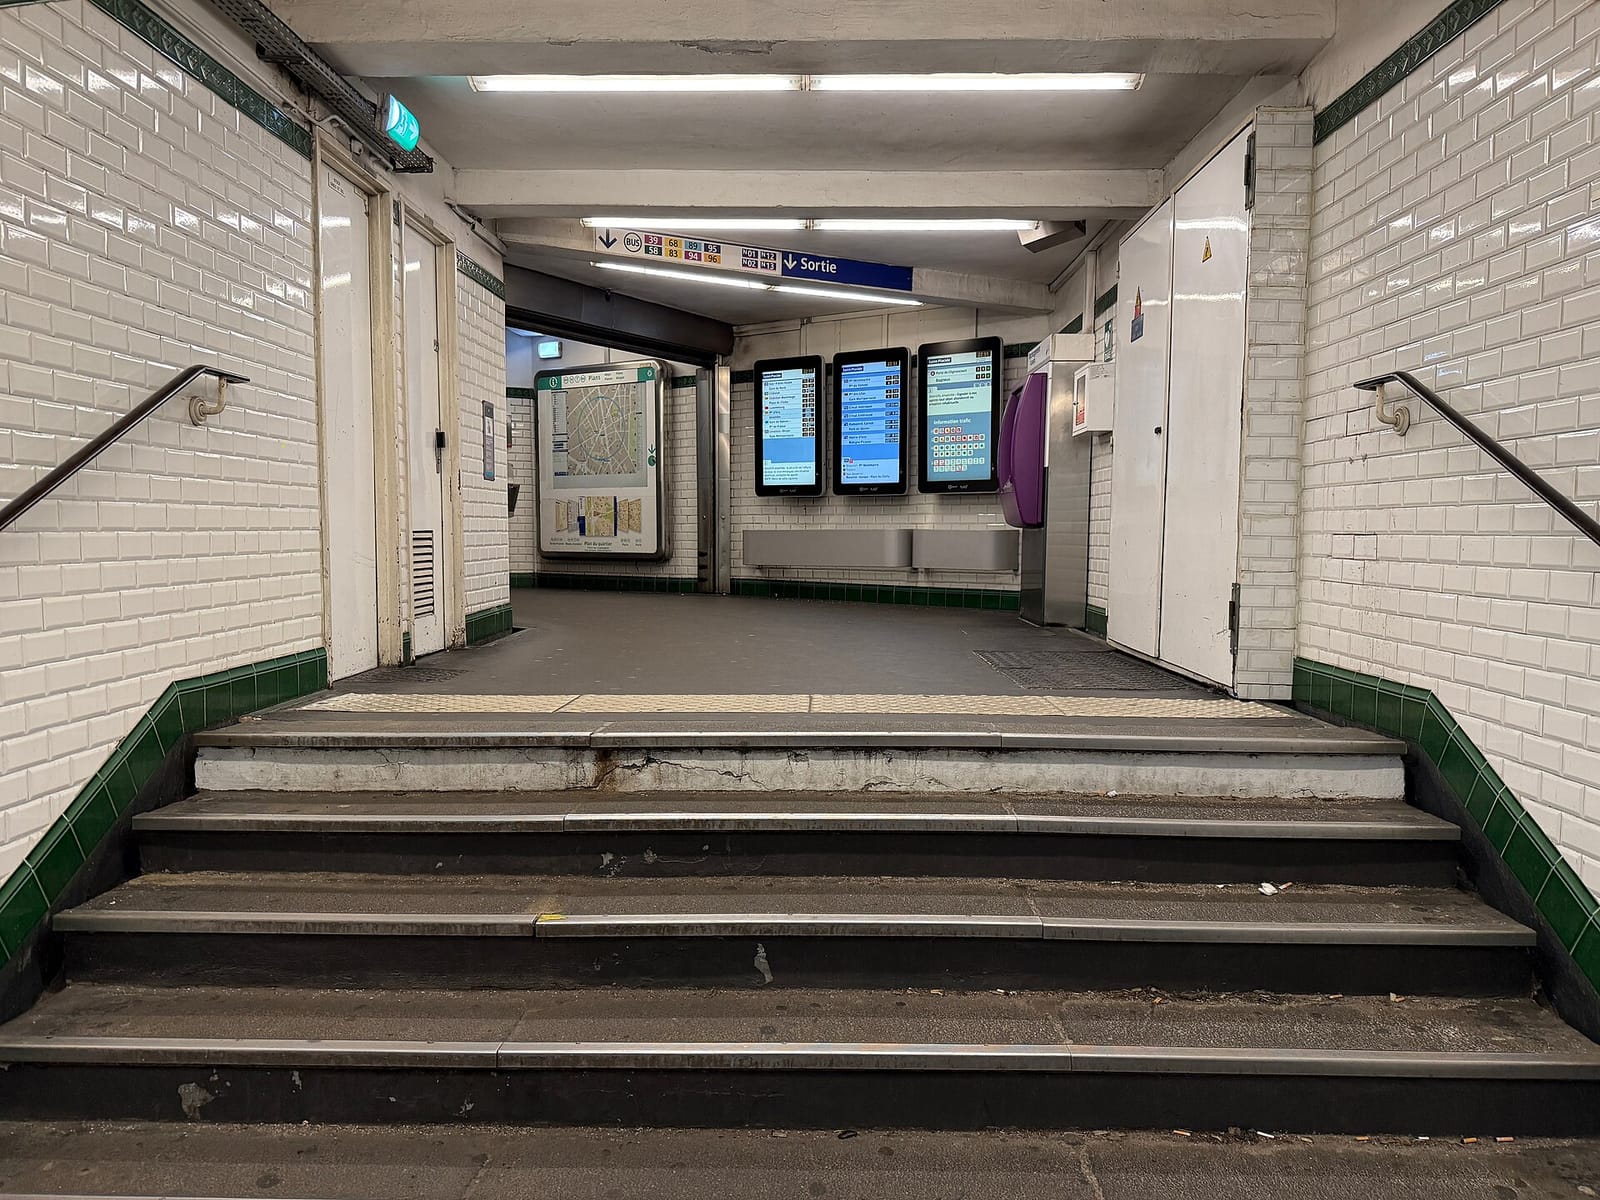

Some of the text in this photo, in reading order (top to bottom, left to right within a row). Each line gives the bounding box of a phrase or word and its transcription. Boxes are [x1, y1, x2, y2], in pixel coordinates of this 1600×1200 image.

[626, 237, 640, 248] BUS
[648, 236, 837, 273] 39 68 89 95 N01 N12 Sortie
[648, 246, 775, 270] 58 83 94 96 N02 N13
